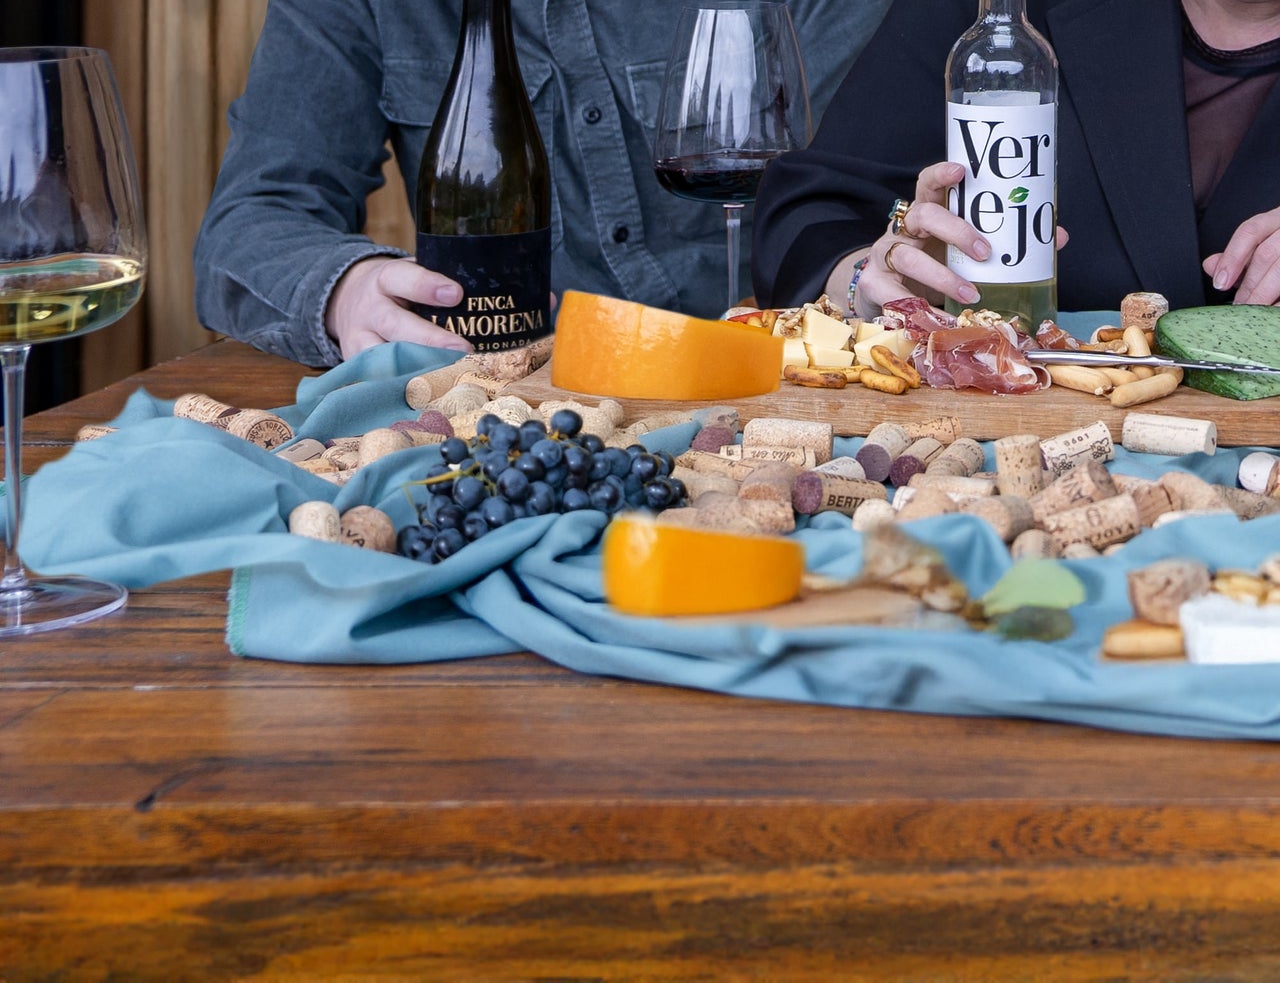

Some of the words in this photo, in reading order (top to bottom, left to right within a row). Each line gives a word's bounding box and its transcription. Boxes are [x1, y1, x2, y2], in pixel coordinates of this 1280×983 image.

[953, 117, 1051, 179] Ver
[467, 295, 515, 312] FINCA
[472, 338, 532, 351] ASIONADA
